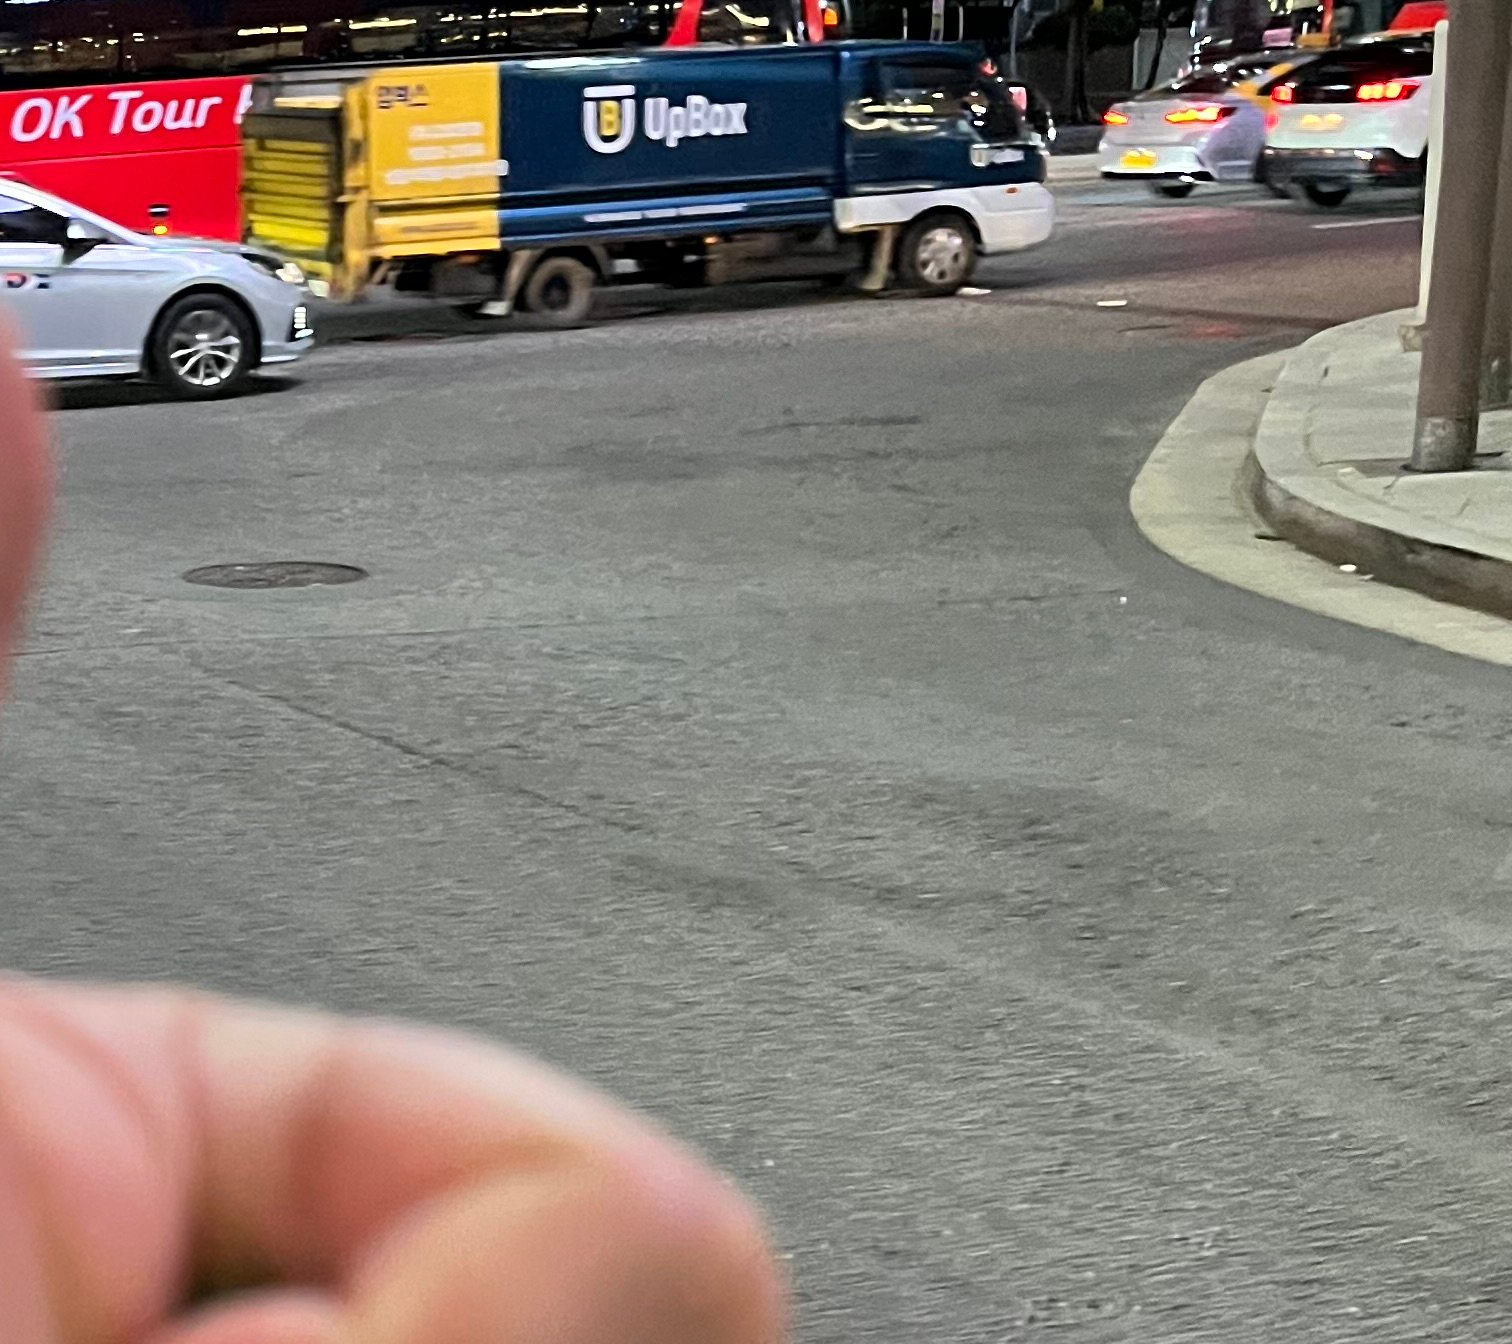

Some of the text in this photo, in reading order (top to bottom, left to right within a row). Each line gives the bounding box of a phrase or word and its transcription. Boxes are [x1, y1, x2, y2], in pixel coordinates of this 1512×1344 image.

[10, 93, 94, 143] OK
[107, 90, 223, 135] Tour
[644, 94, 748, 148] UpBox
